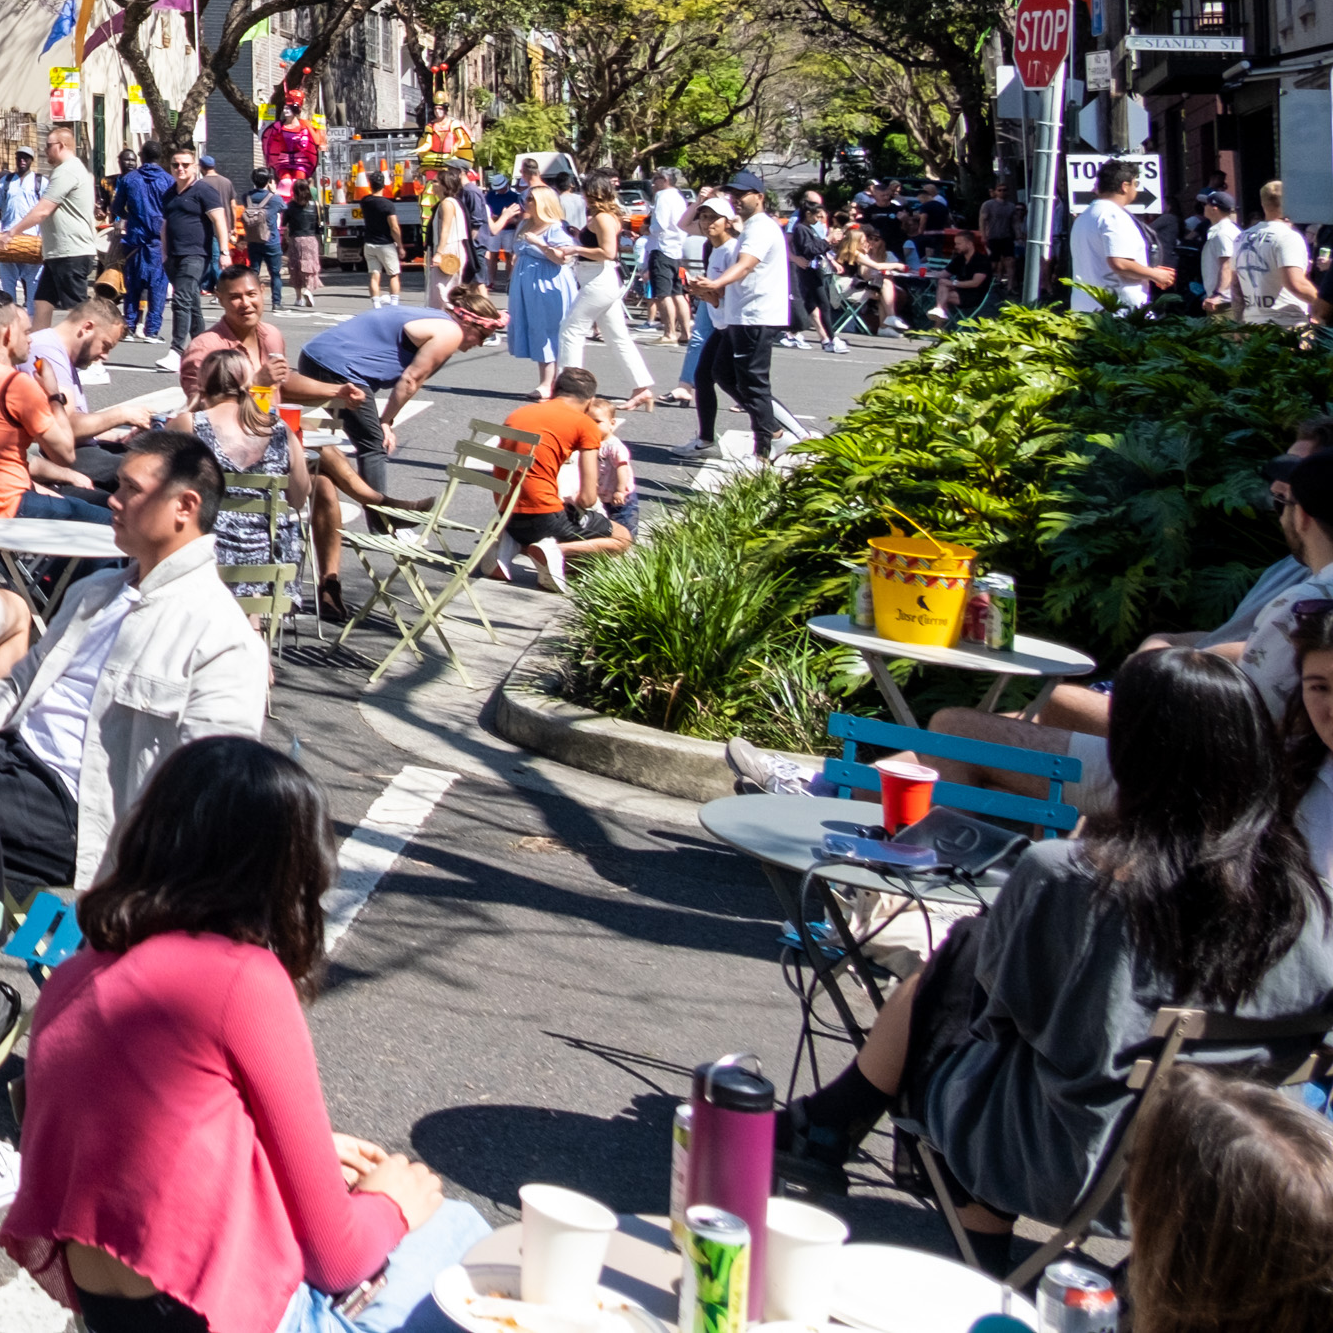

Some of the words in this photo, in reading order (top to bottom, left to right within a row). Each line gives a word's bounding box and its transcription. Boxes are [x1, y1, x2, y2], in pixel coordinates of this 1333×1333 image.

[1018, 9, 1067, 53] STOP
[1144, 38, 1211, 50] STANLEY
[1220, 38, 1240, 50] ST
